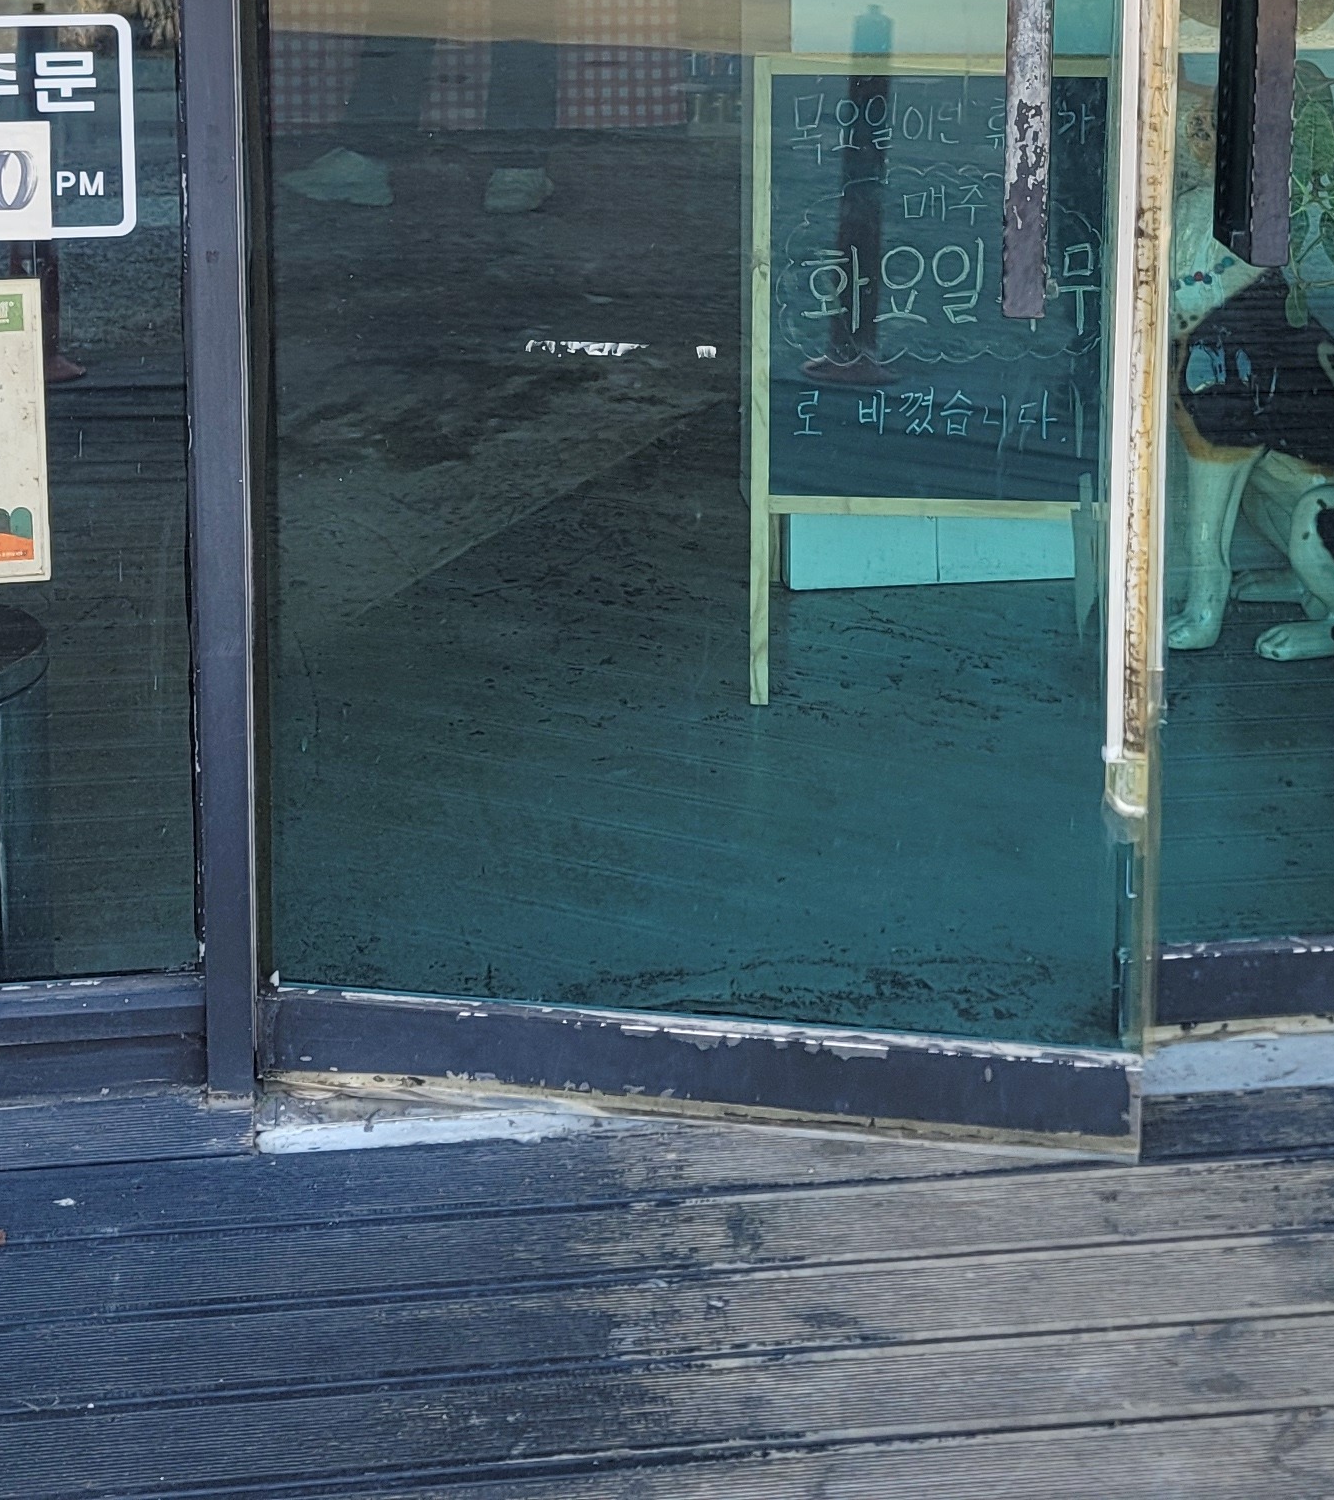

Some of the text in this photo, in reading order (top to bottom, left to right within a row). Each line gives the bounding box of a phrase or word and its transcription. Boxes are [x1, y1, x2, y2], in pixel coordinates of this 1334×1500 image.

[54, 170, 106, 199] PM
[902, 184, 989, 227] 매주
[799, 236, 986, 335] 화요일
[793, 389, 823, 436] 로
